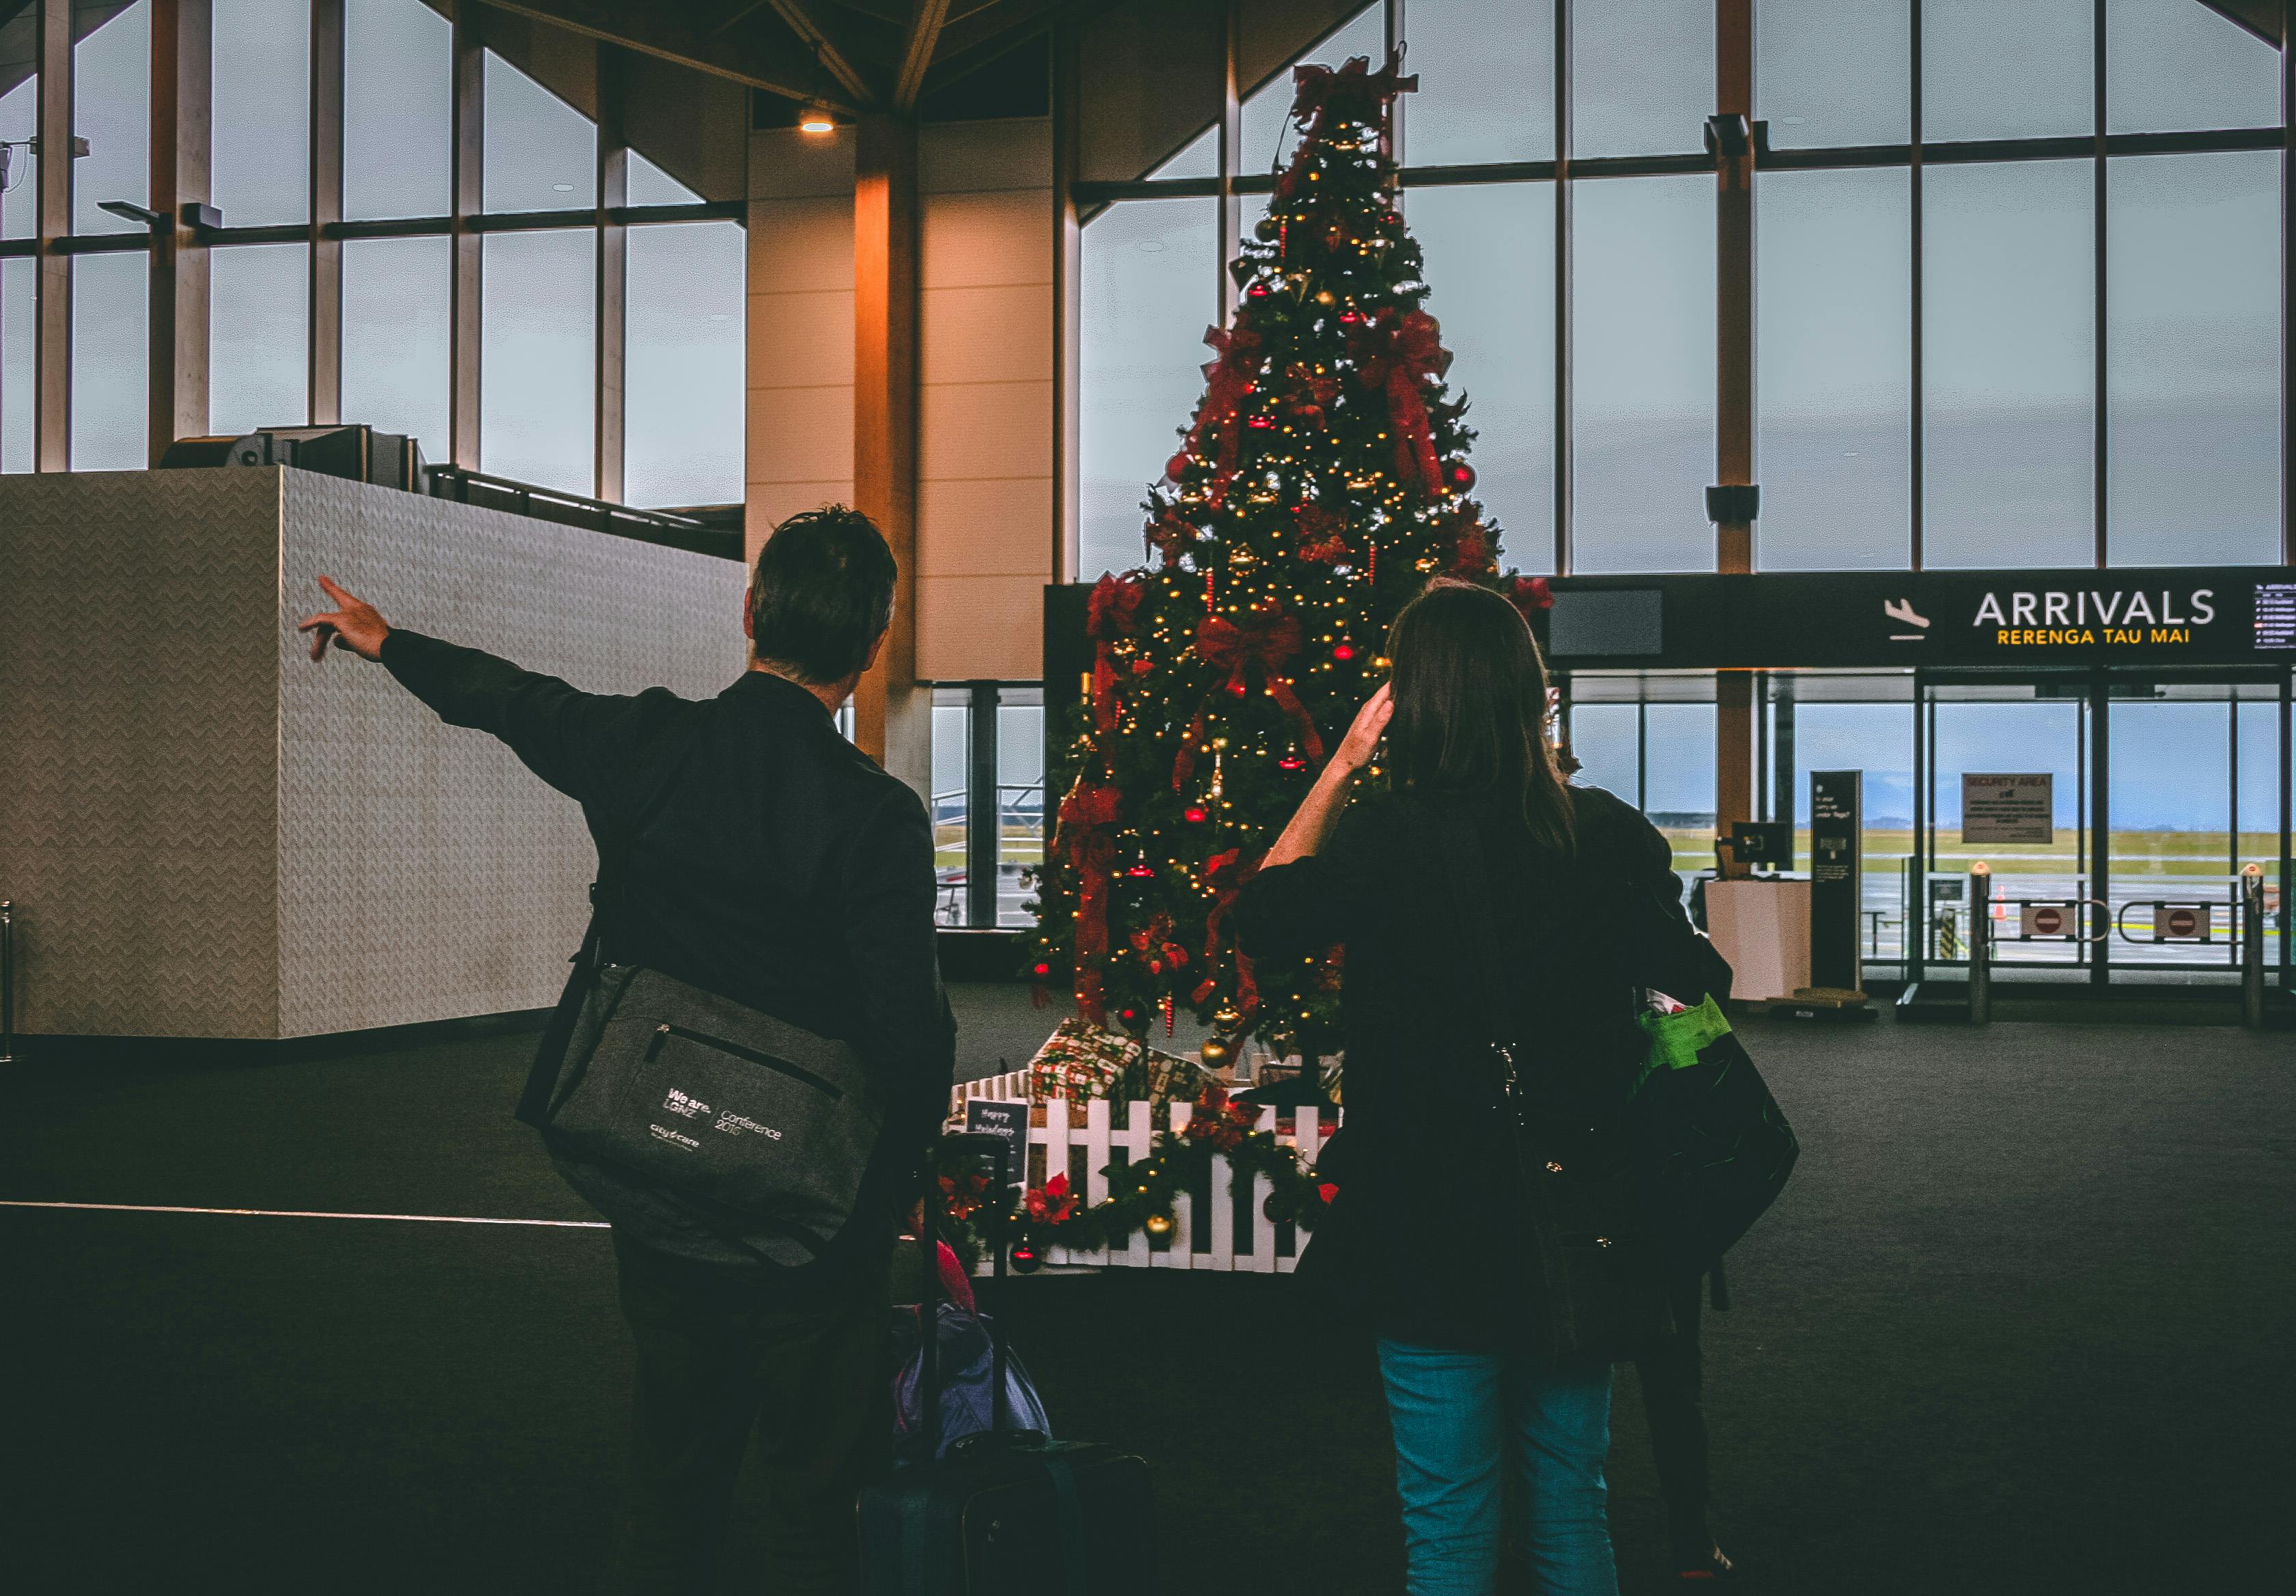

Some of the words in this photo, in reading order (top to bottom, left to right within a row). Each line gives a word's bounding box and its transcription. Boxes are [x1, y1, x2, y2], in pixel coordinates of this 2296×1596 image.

[1972, 589, 2215, 627] ARRIVALS
[1997, 629, 2096, 645] RERENGA
[2103, 629, 2142, 644] TAU
[2150, 628, 2190, 644] MAI
[668, 1088, 688, 1104] We
[721, 1110, 782, 1140] Conference
